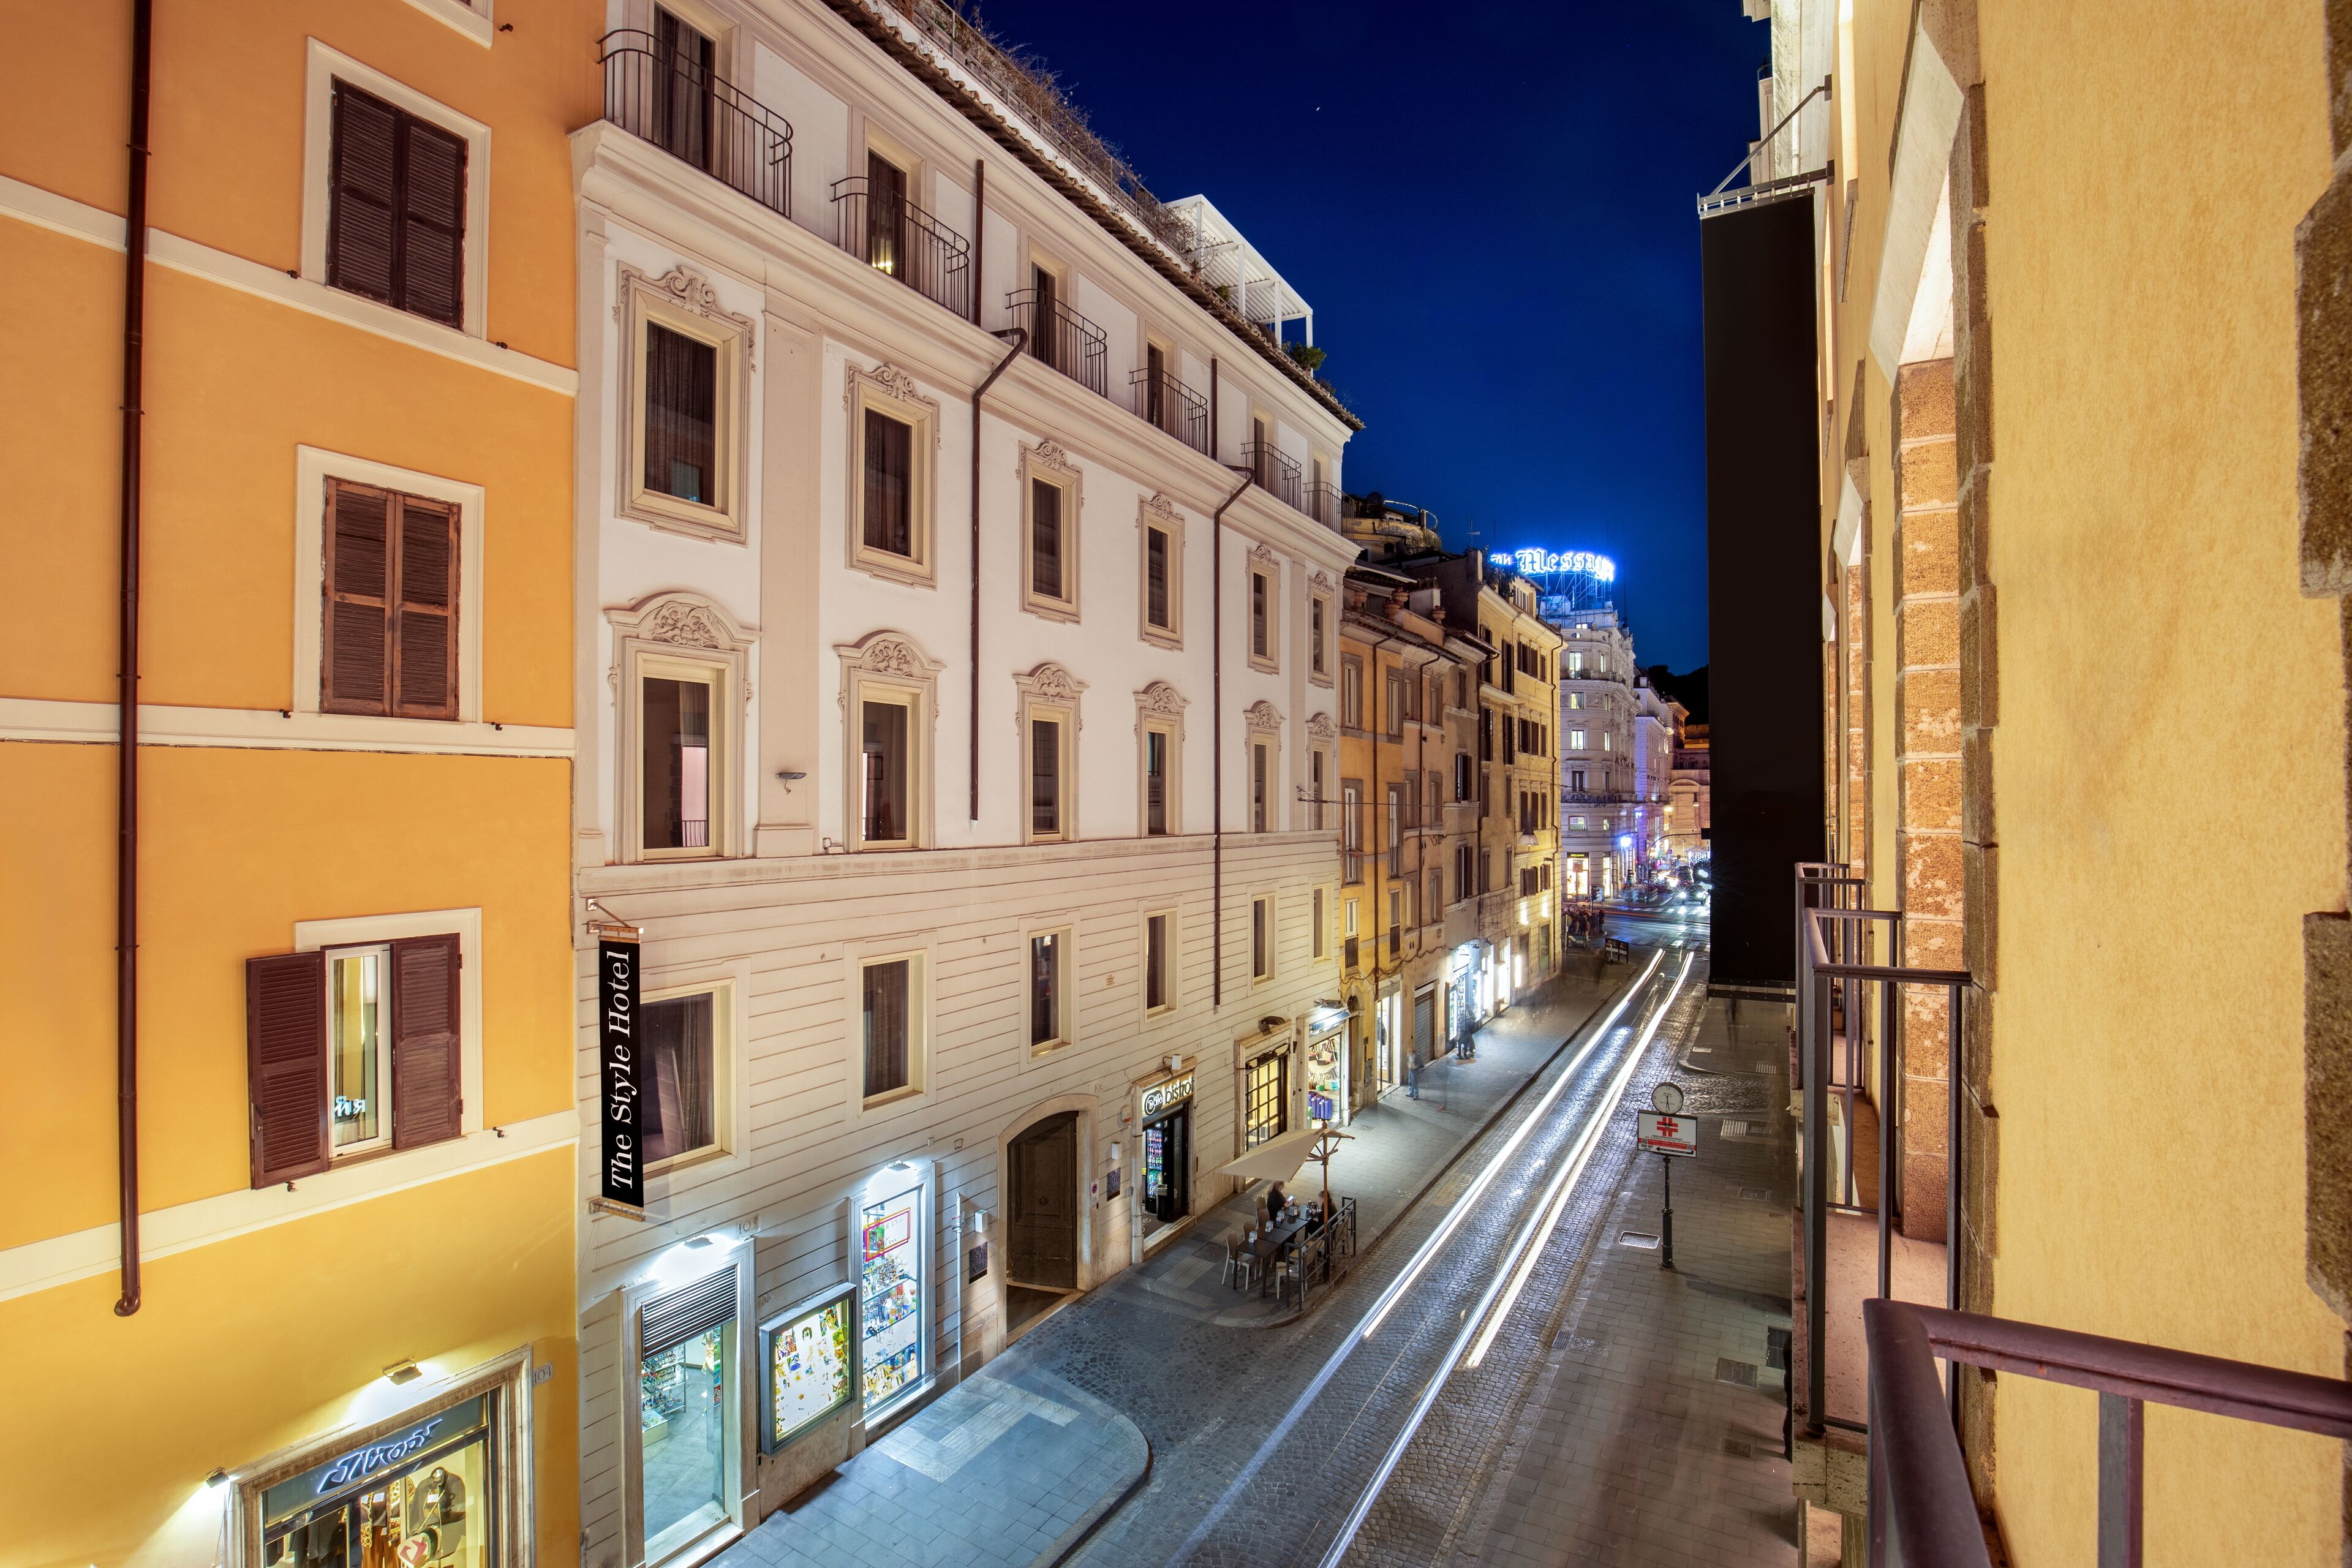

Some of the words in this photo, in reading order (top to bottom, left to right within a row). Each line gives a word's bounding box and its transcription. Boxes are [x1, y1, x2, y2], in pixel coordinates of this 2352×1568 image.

[606, 951, 630, 1038] Hotel
[610, 1044, 637, 1126] Style
[1164, 1076, 1195, 1105] bistrot
[611, 1134, 633, 1189] The
[534, 1365, 551, 1383] 104
